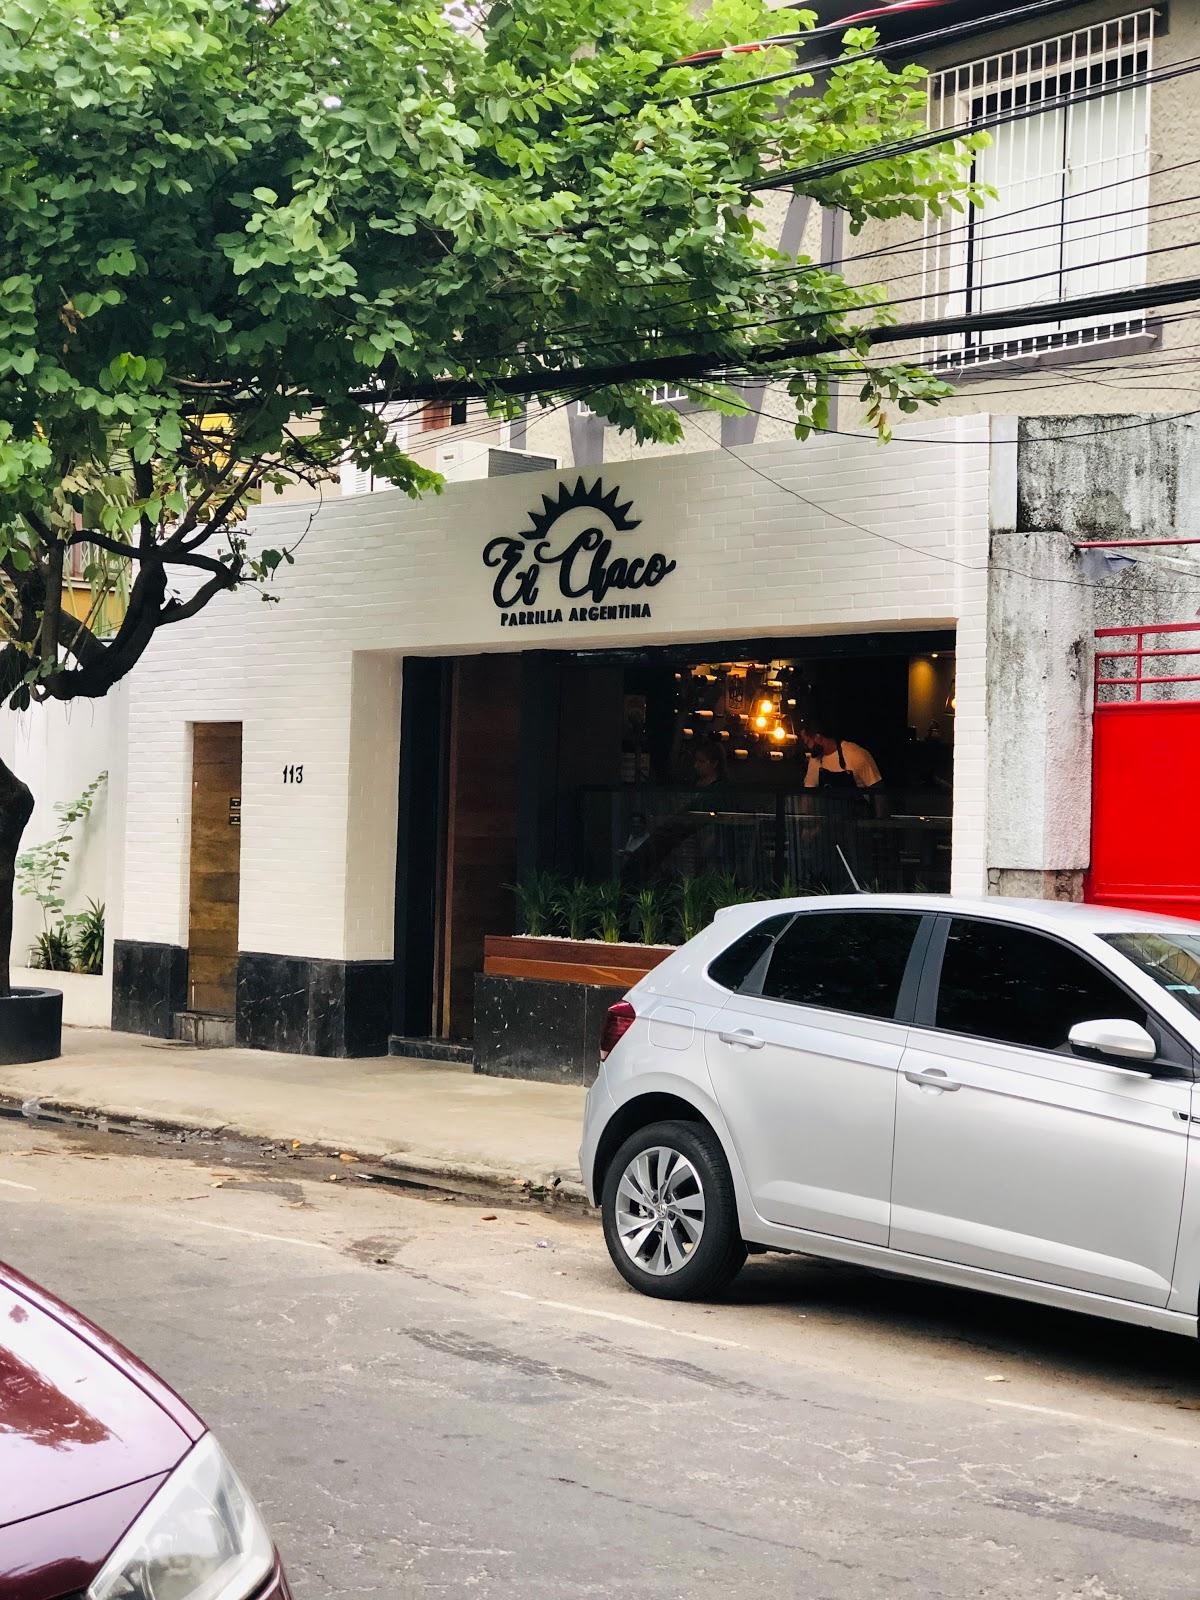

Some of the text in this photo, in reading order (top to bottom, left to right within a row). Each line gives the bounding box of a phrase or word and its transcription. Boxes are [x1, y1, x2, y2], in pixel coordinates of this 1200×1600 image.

[482, 527, 677, 608] El Chaco
[500, 603, 652, 626] PARRILLA ARGENTINA
[282, 764, 304, 784] 113
